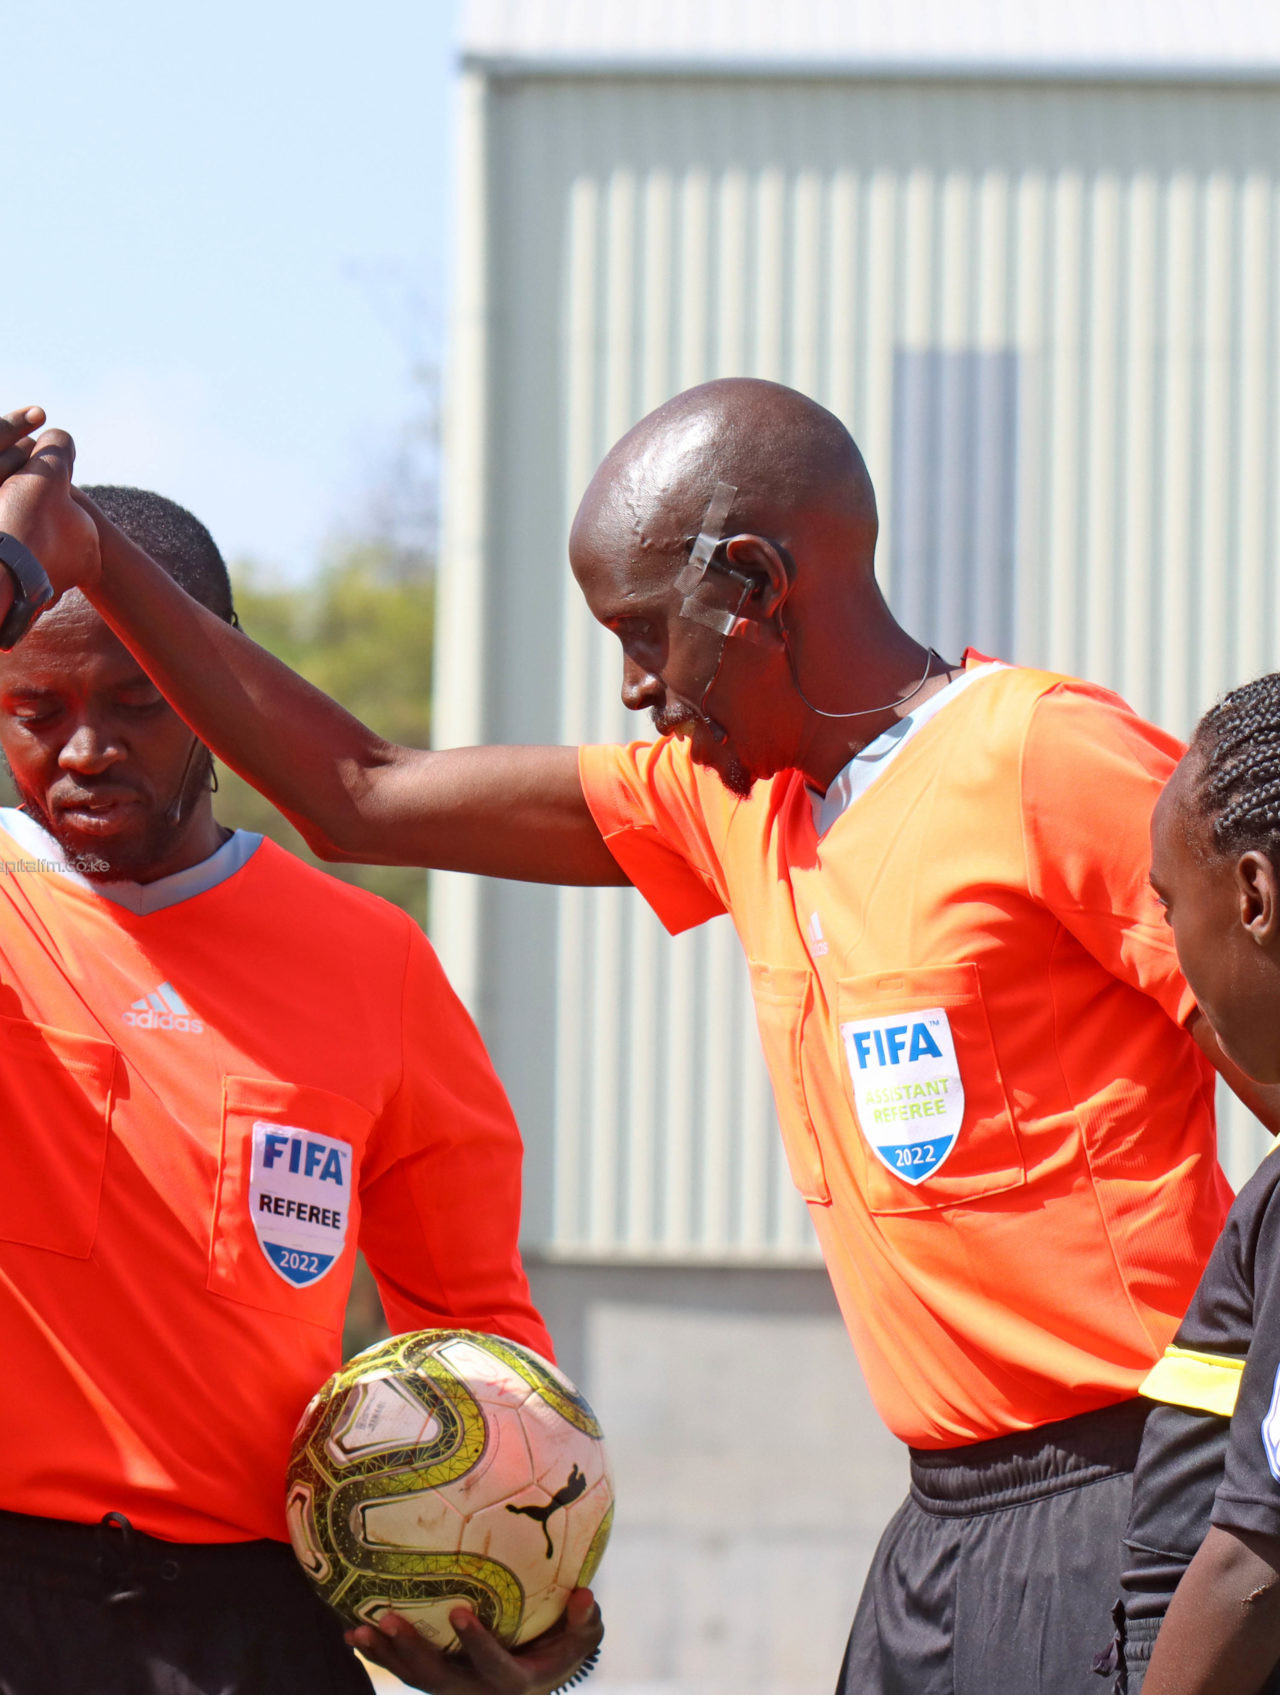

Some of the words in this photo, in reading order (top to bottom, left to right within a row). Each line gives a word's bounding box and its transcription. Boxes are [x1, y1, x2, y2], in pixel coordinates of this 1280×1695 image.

[122, 1009, 204, 1035] adidas
[852, 1022, 943, 1069] FIFA
[866, 1078, 949, 1104] ASSISTANT
[873, 1099, 947, 1124] REFEREE
[262, 1133, 344, 1186] FIFA
[894, 1144, 937, 1168] 2022
[259, 1193, 341, 1229] REFEREE
[279, 1250, 320, 1274] 2022
